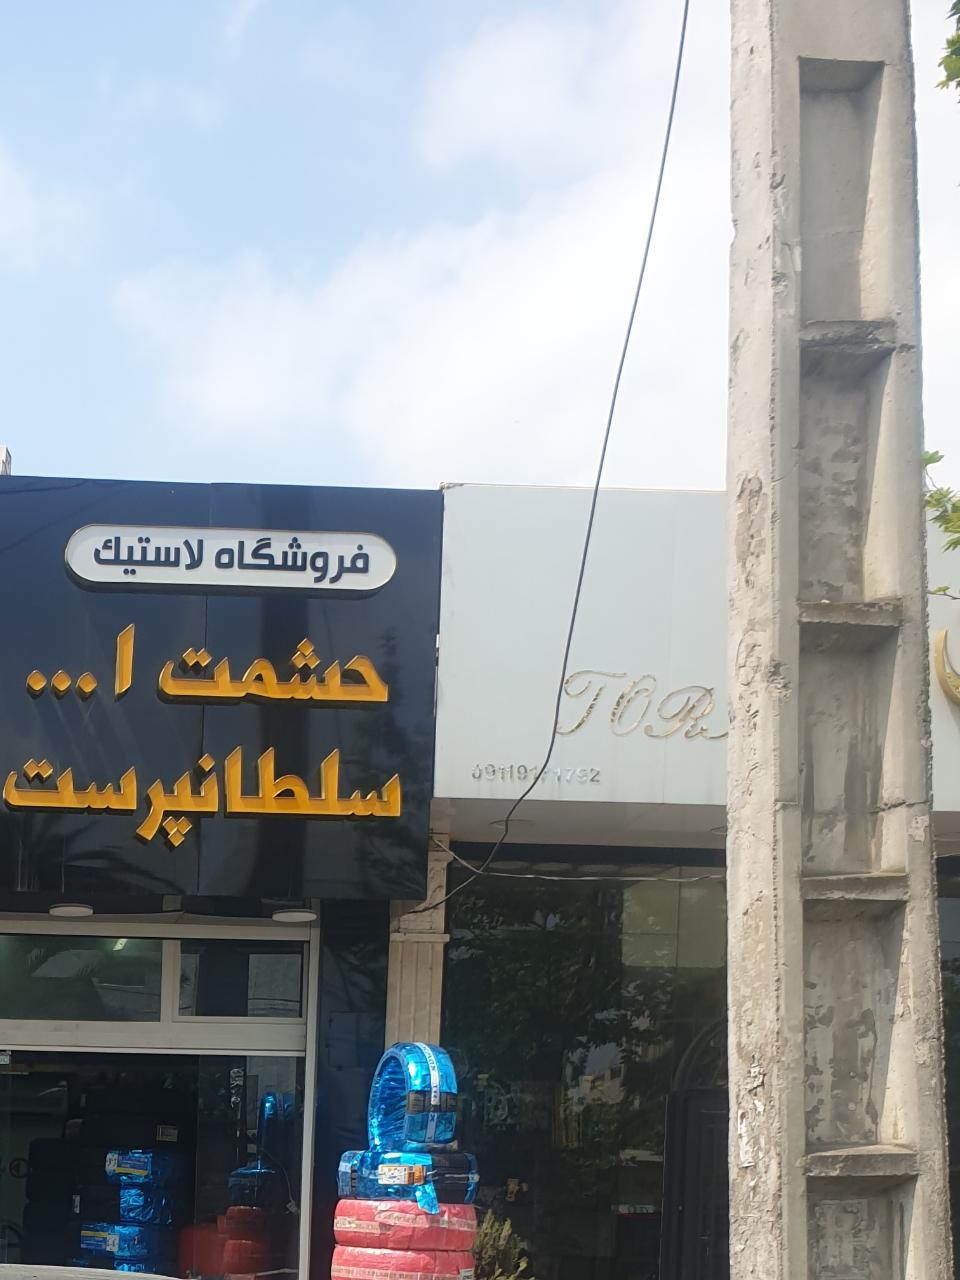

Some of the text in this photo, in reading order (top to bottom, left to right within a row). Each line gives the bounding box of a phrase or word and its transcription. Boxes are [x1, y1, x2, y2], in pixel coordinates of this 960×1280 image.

[214, 536, 370, 584] فروشگاه
[158, 639, 390, 703] حشمت
[3, 748, 402, 847] سلطانپرست
